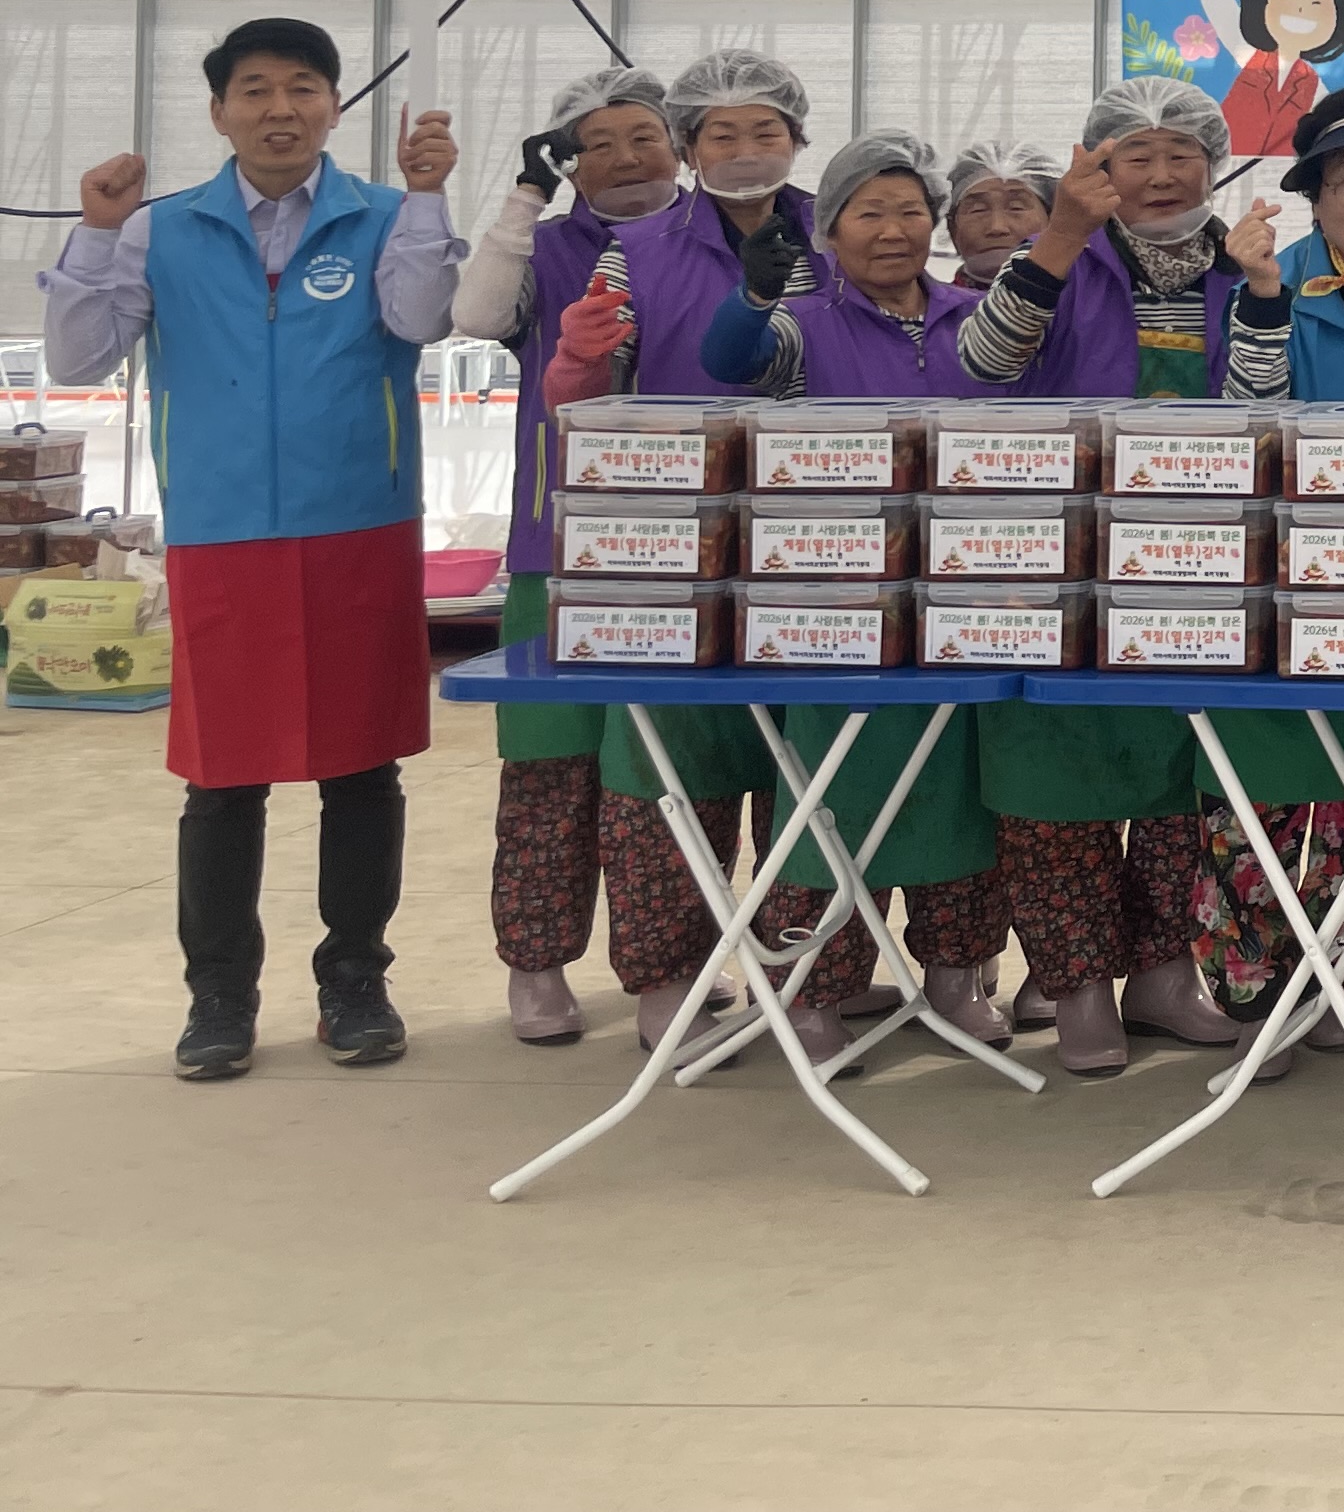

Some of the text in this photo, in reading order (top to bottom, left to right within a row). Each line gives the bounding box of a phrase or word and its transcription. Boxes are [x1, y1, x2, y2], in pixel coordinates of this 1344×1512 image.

[580, 437, 614, 449] 2026년
[769, 439, 803, 450] 2026년
[951, 438, 985, 449] 2026년
[1129, 441, 1163, 452] 2026년
[1307, 444, 1342, 456] 2026년
[1119, 615, 1154, 626] 2026년
